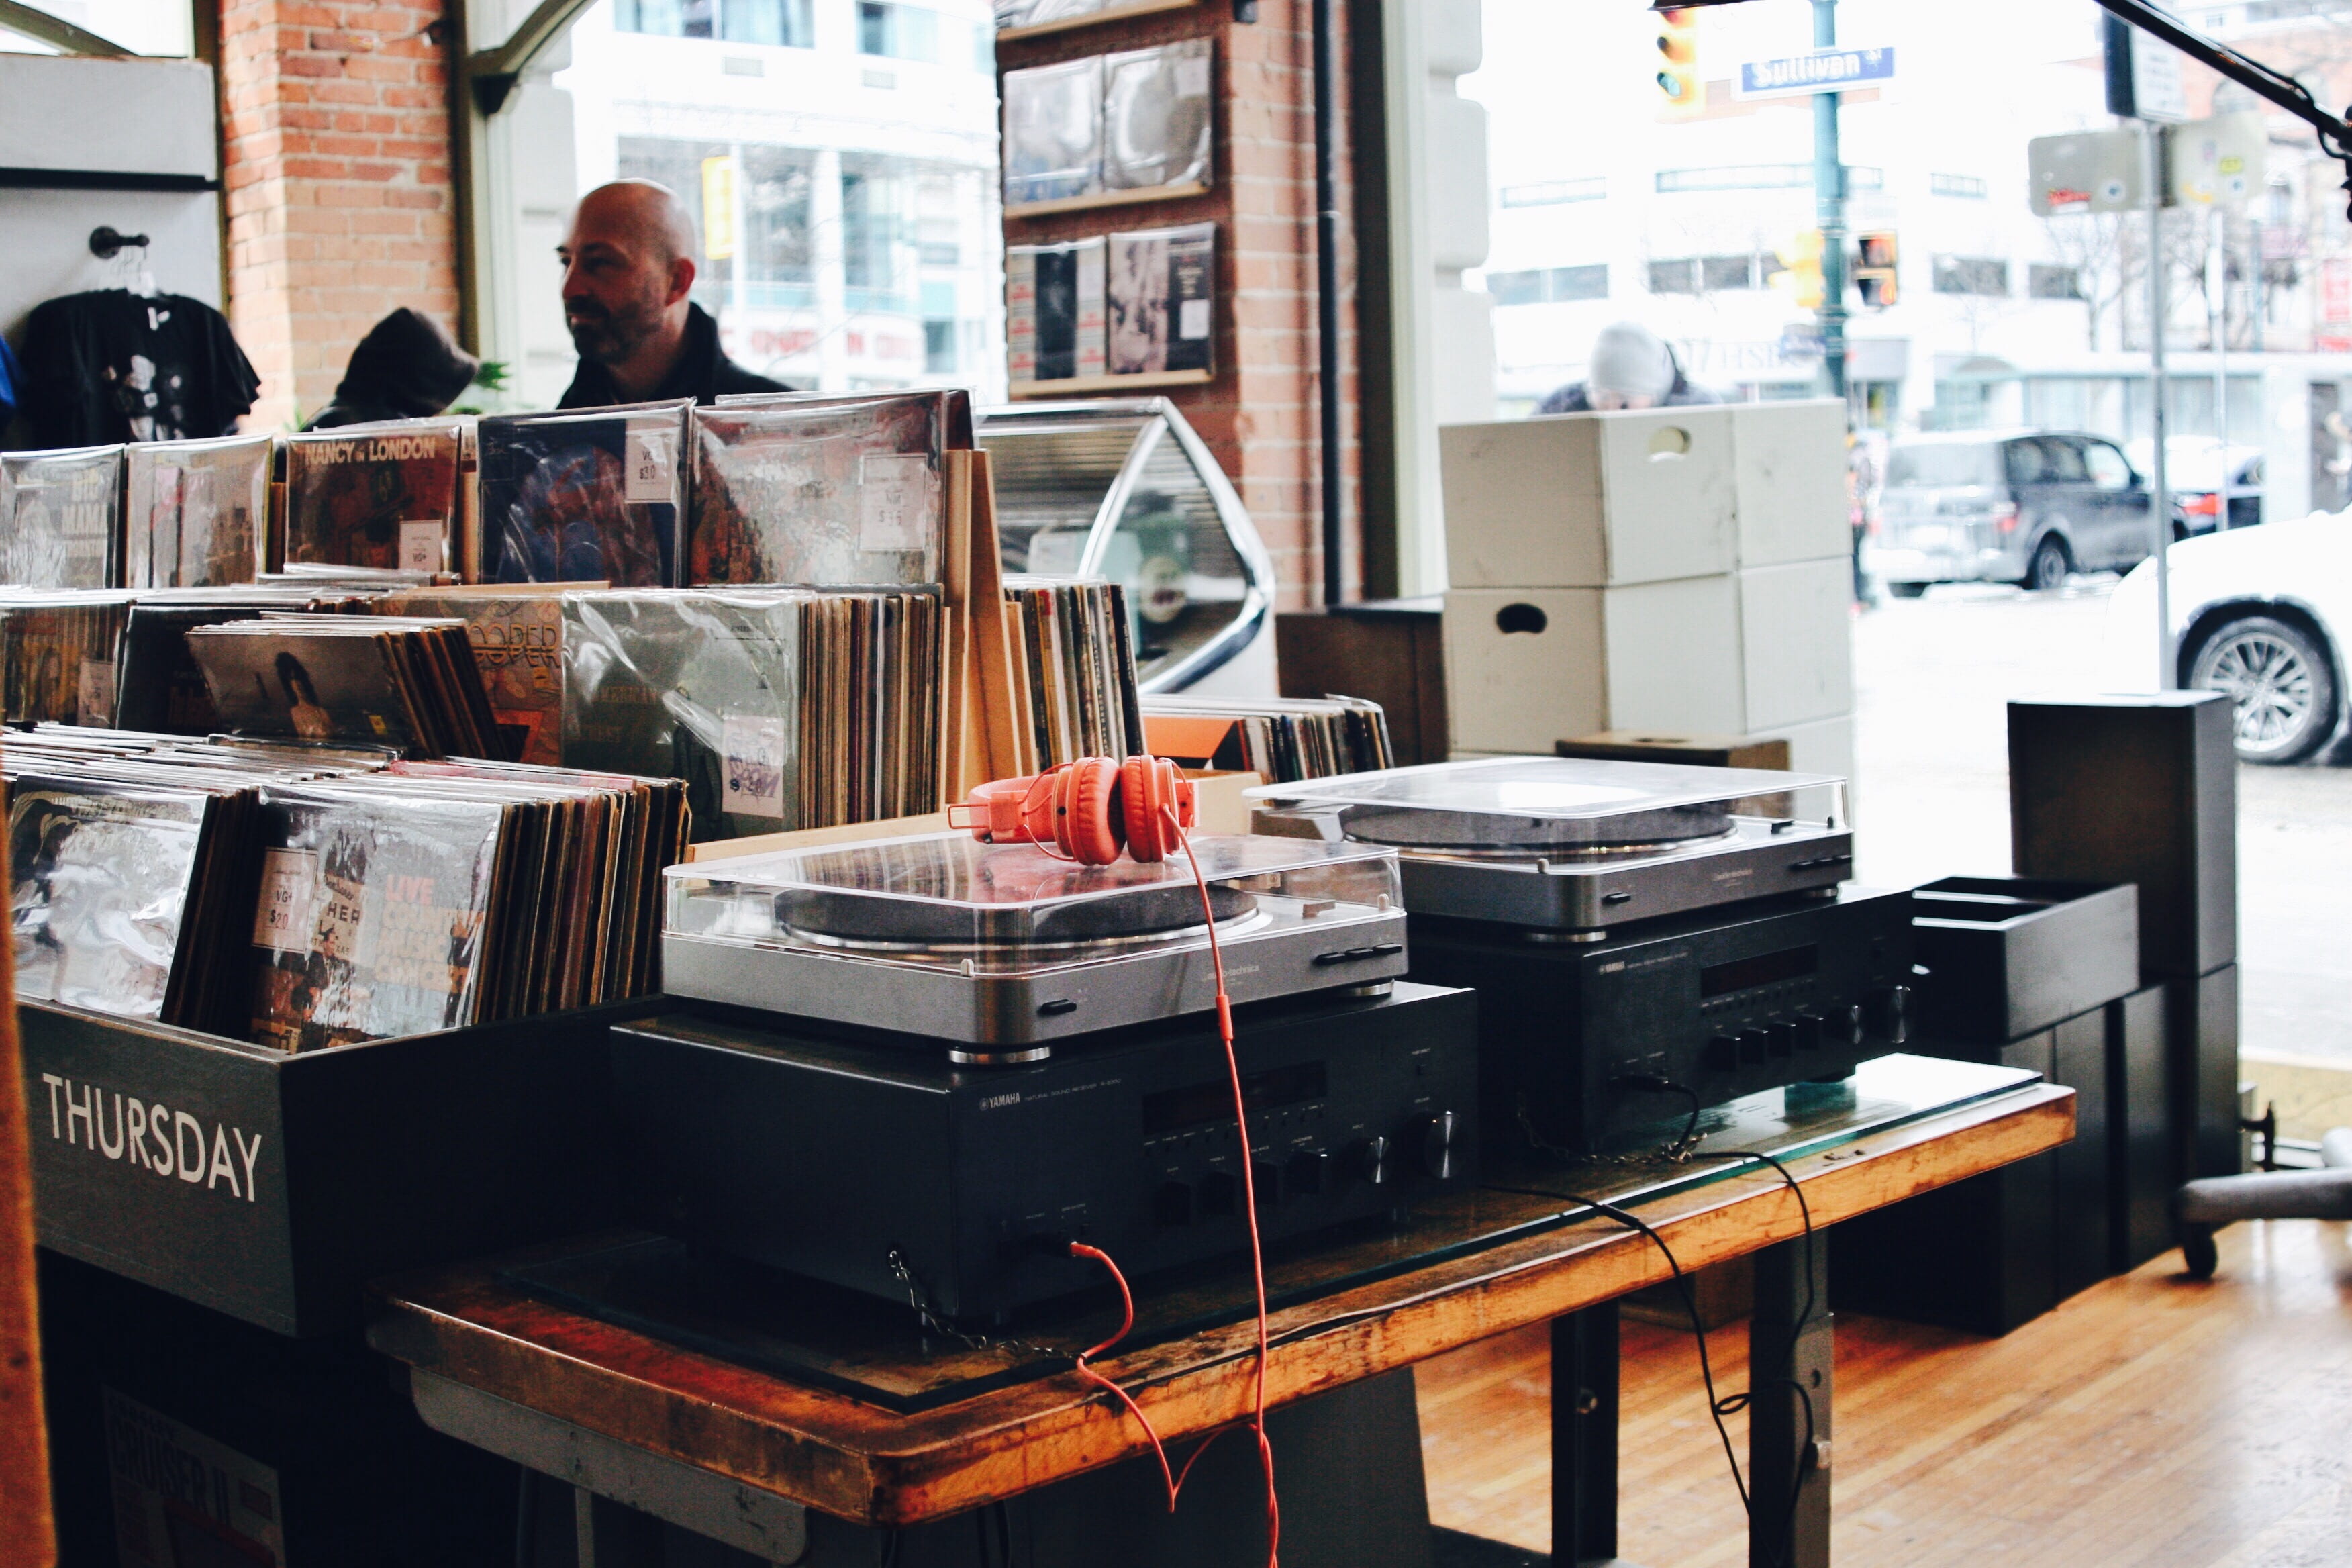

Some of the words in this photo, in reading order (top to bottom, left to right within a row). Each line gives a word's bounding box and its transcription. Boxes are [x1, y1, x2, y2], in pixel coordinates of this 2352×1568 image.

[1753, 54, 1860, 87] Sullivan
[305, 442, 355, 464] NANCY
[369, 437, 435, 462] LONDON
[468, 622, 562, 668] OOPER
[276, 889, 293, 903] VG+
[385, 874, 436, 906] LIVE
[269, 909, 289, 930] $20
[989, 1091, 1021, 1108] YAMAHA
[43, 1072, 262, 1202] THURSDAY
[111, 1413, 209, 1518] CRUISER
